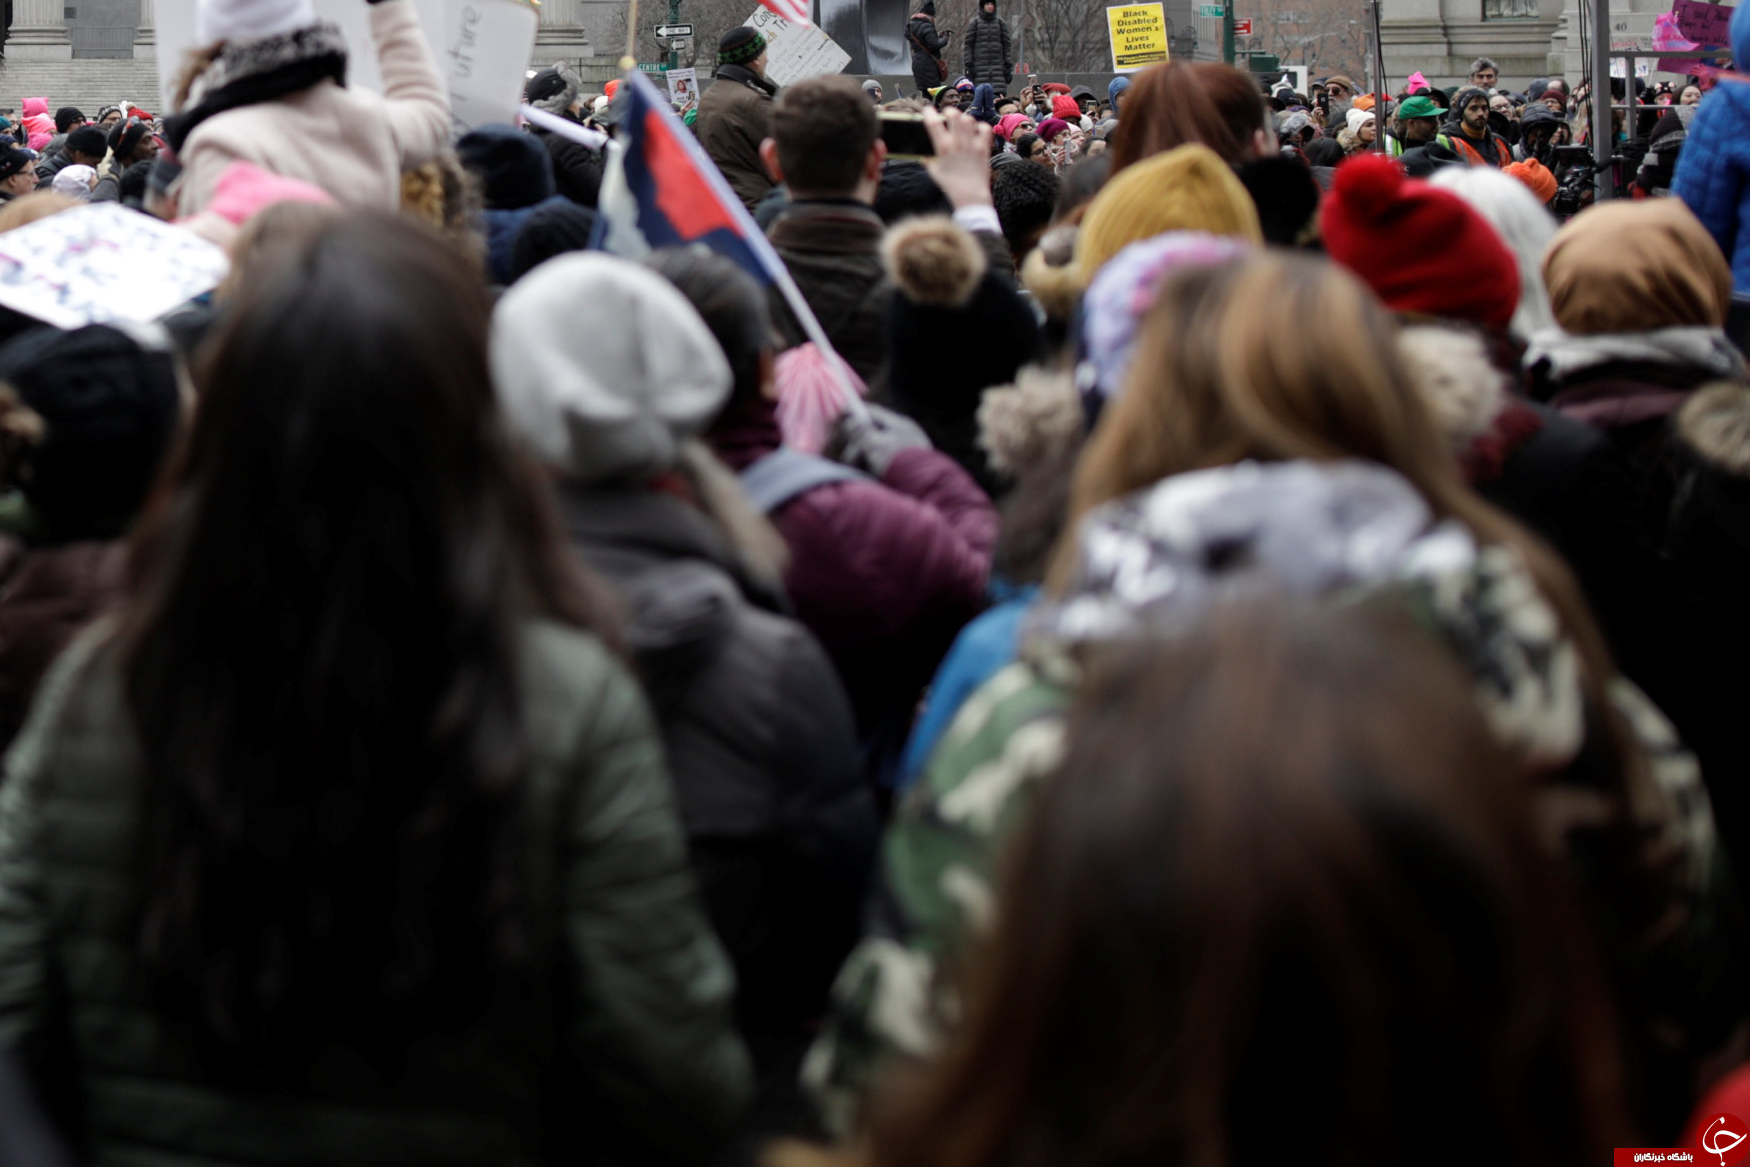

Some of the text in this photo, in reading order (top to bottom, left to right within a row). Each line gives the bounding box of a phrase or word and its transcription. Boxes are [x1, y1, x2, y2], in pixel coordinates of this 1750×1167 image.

[1122, 10, 1148, 18] Black
[1117, 17, 1158, 27] Disabled
[1126, 35, 1149, 43] Lives
[1124, 43, 1156, 51] Matter
[638, 64, 660, 72] CENTRE
